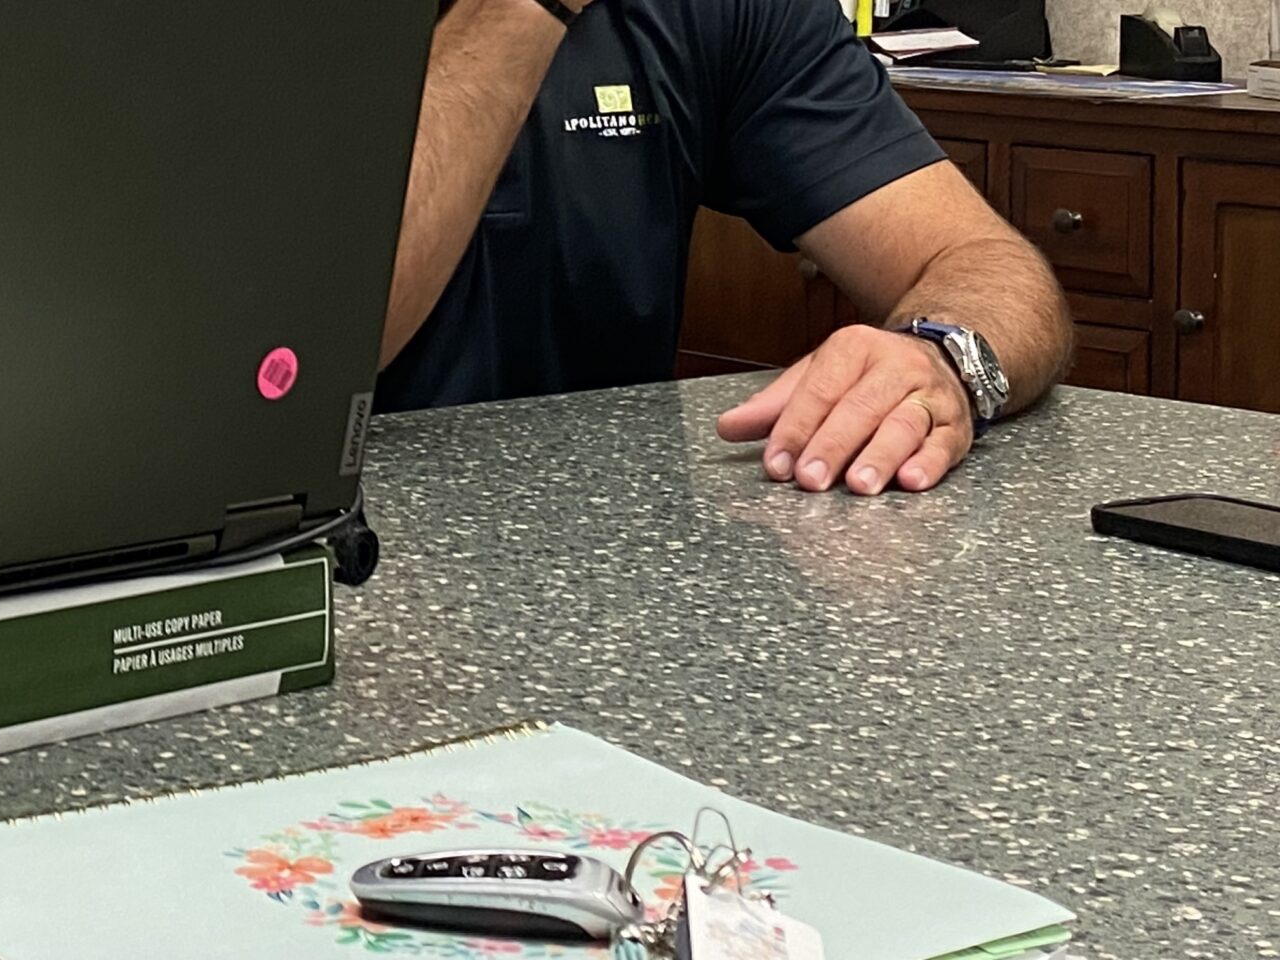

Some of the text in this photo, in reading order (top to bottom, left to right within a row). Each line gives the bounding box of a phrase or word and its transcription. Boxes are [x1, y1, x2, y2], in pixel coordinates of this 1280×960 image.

[345, 399, 368, 468] Lenovo
[113, 609, 223, 644] MULTI-USE COPY PAPER
[113, 652, 148, 675] PAPIER
[158, 643, 194, 666] USAGES
[195, 634, 245, 659] MULTIPLES
